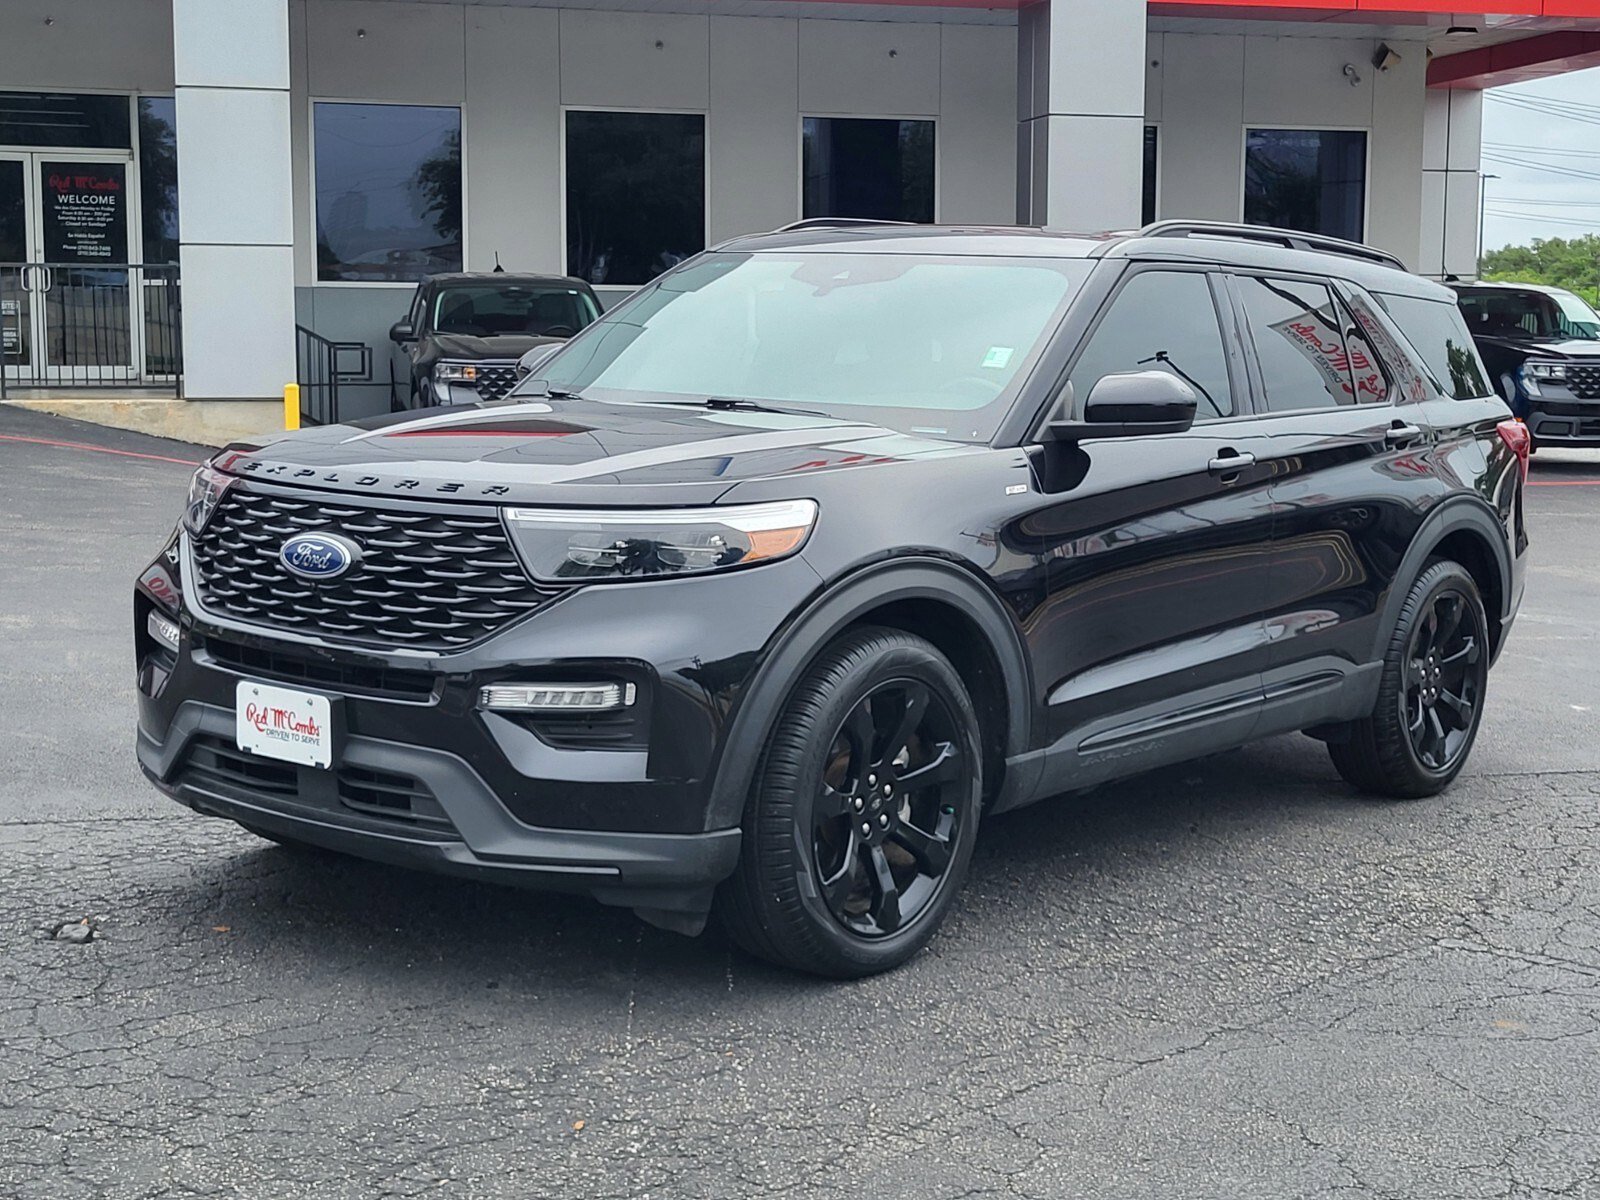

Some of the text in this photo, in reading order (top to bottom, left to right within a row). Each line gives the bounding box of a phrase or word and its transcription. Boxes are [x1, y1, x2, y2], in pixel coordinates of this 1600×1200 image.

[57, 194, 116, 205] WELCOME
[243, 462, 510, 496] EXPLORER
[293, 543, 330, 570] Ford
[246, 702, 320, 737] Red McCombs
[265, 729, 320, 747] DRIVEN TO SERVE
